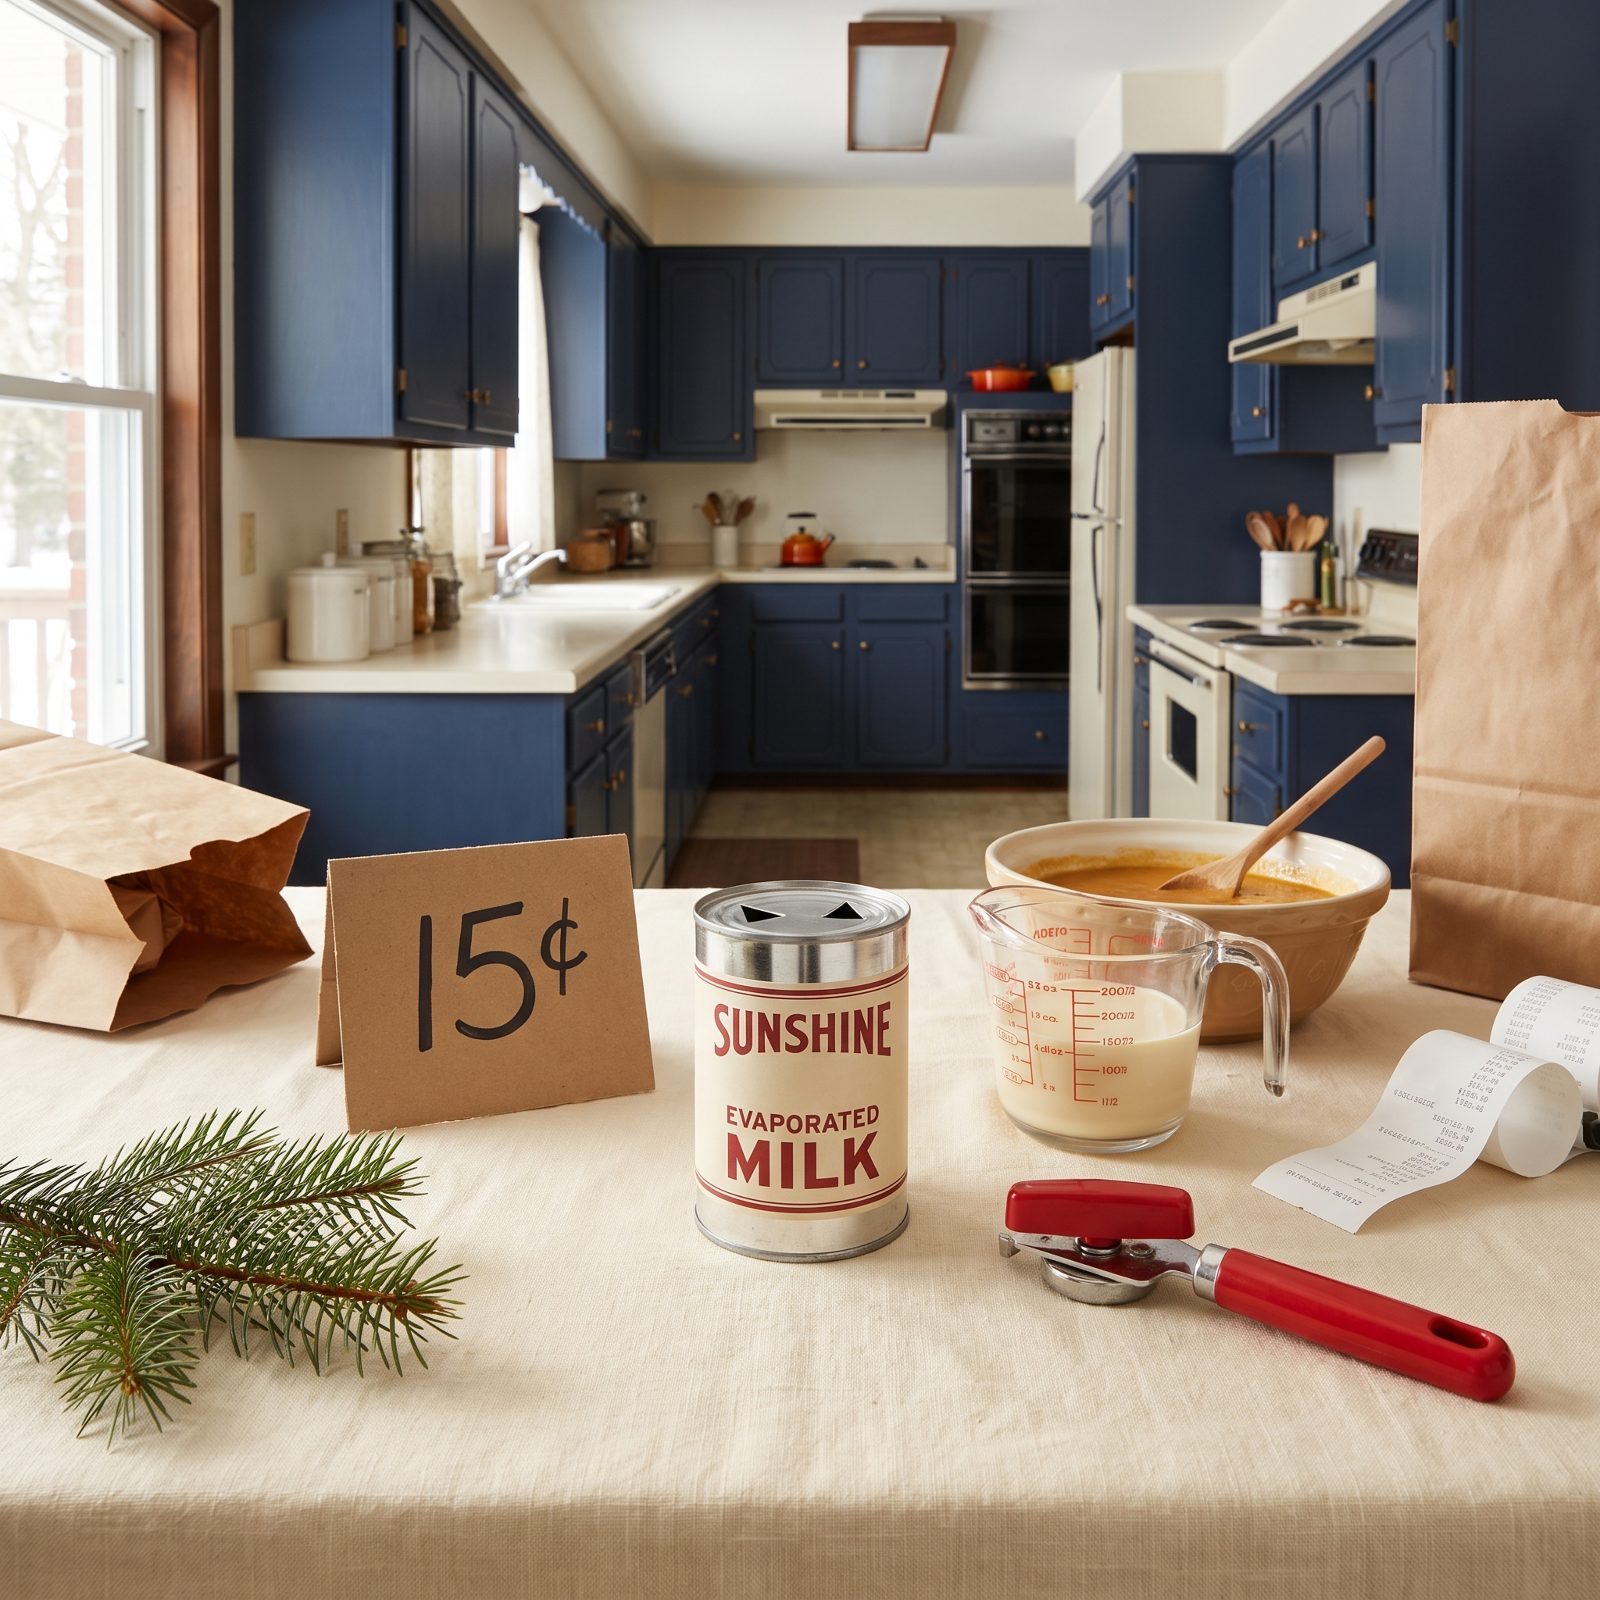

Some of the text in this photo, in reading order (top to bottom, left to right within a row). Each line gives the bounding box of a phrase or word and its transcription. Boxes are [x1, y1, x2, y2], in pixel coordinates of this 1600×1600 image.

[418, 897, 588, 1052] 15¢
[714, 1001, 892, 1057] SUNSHINE
[726, 1104, 880, 1134] EVAPORATED
[727, 1130, 880, 1190] MILK
